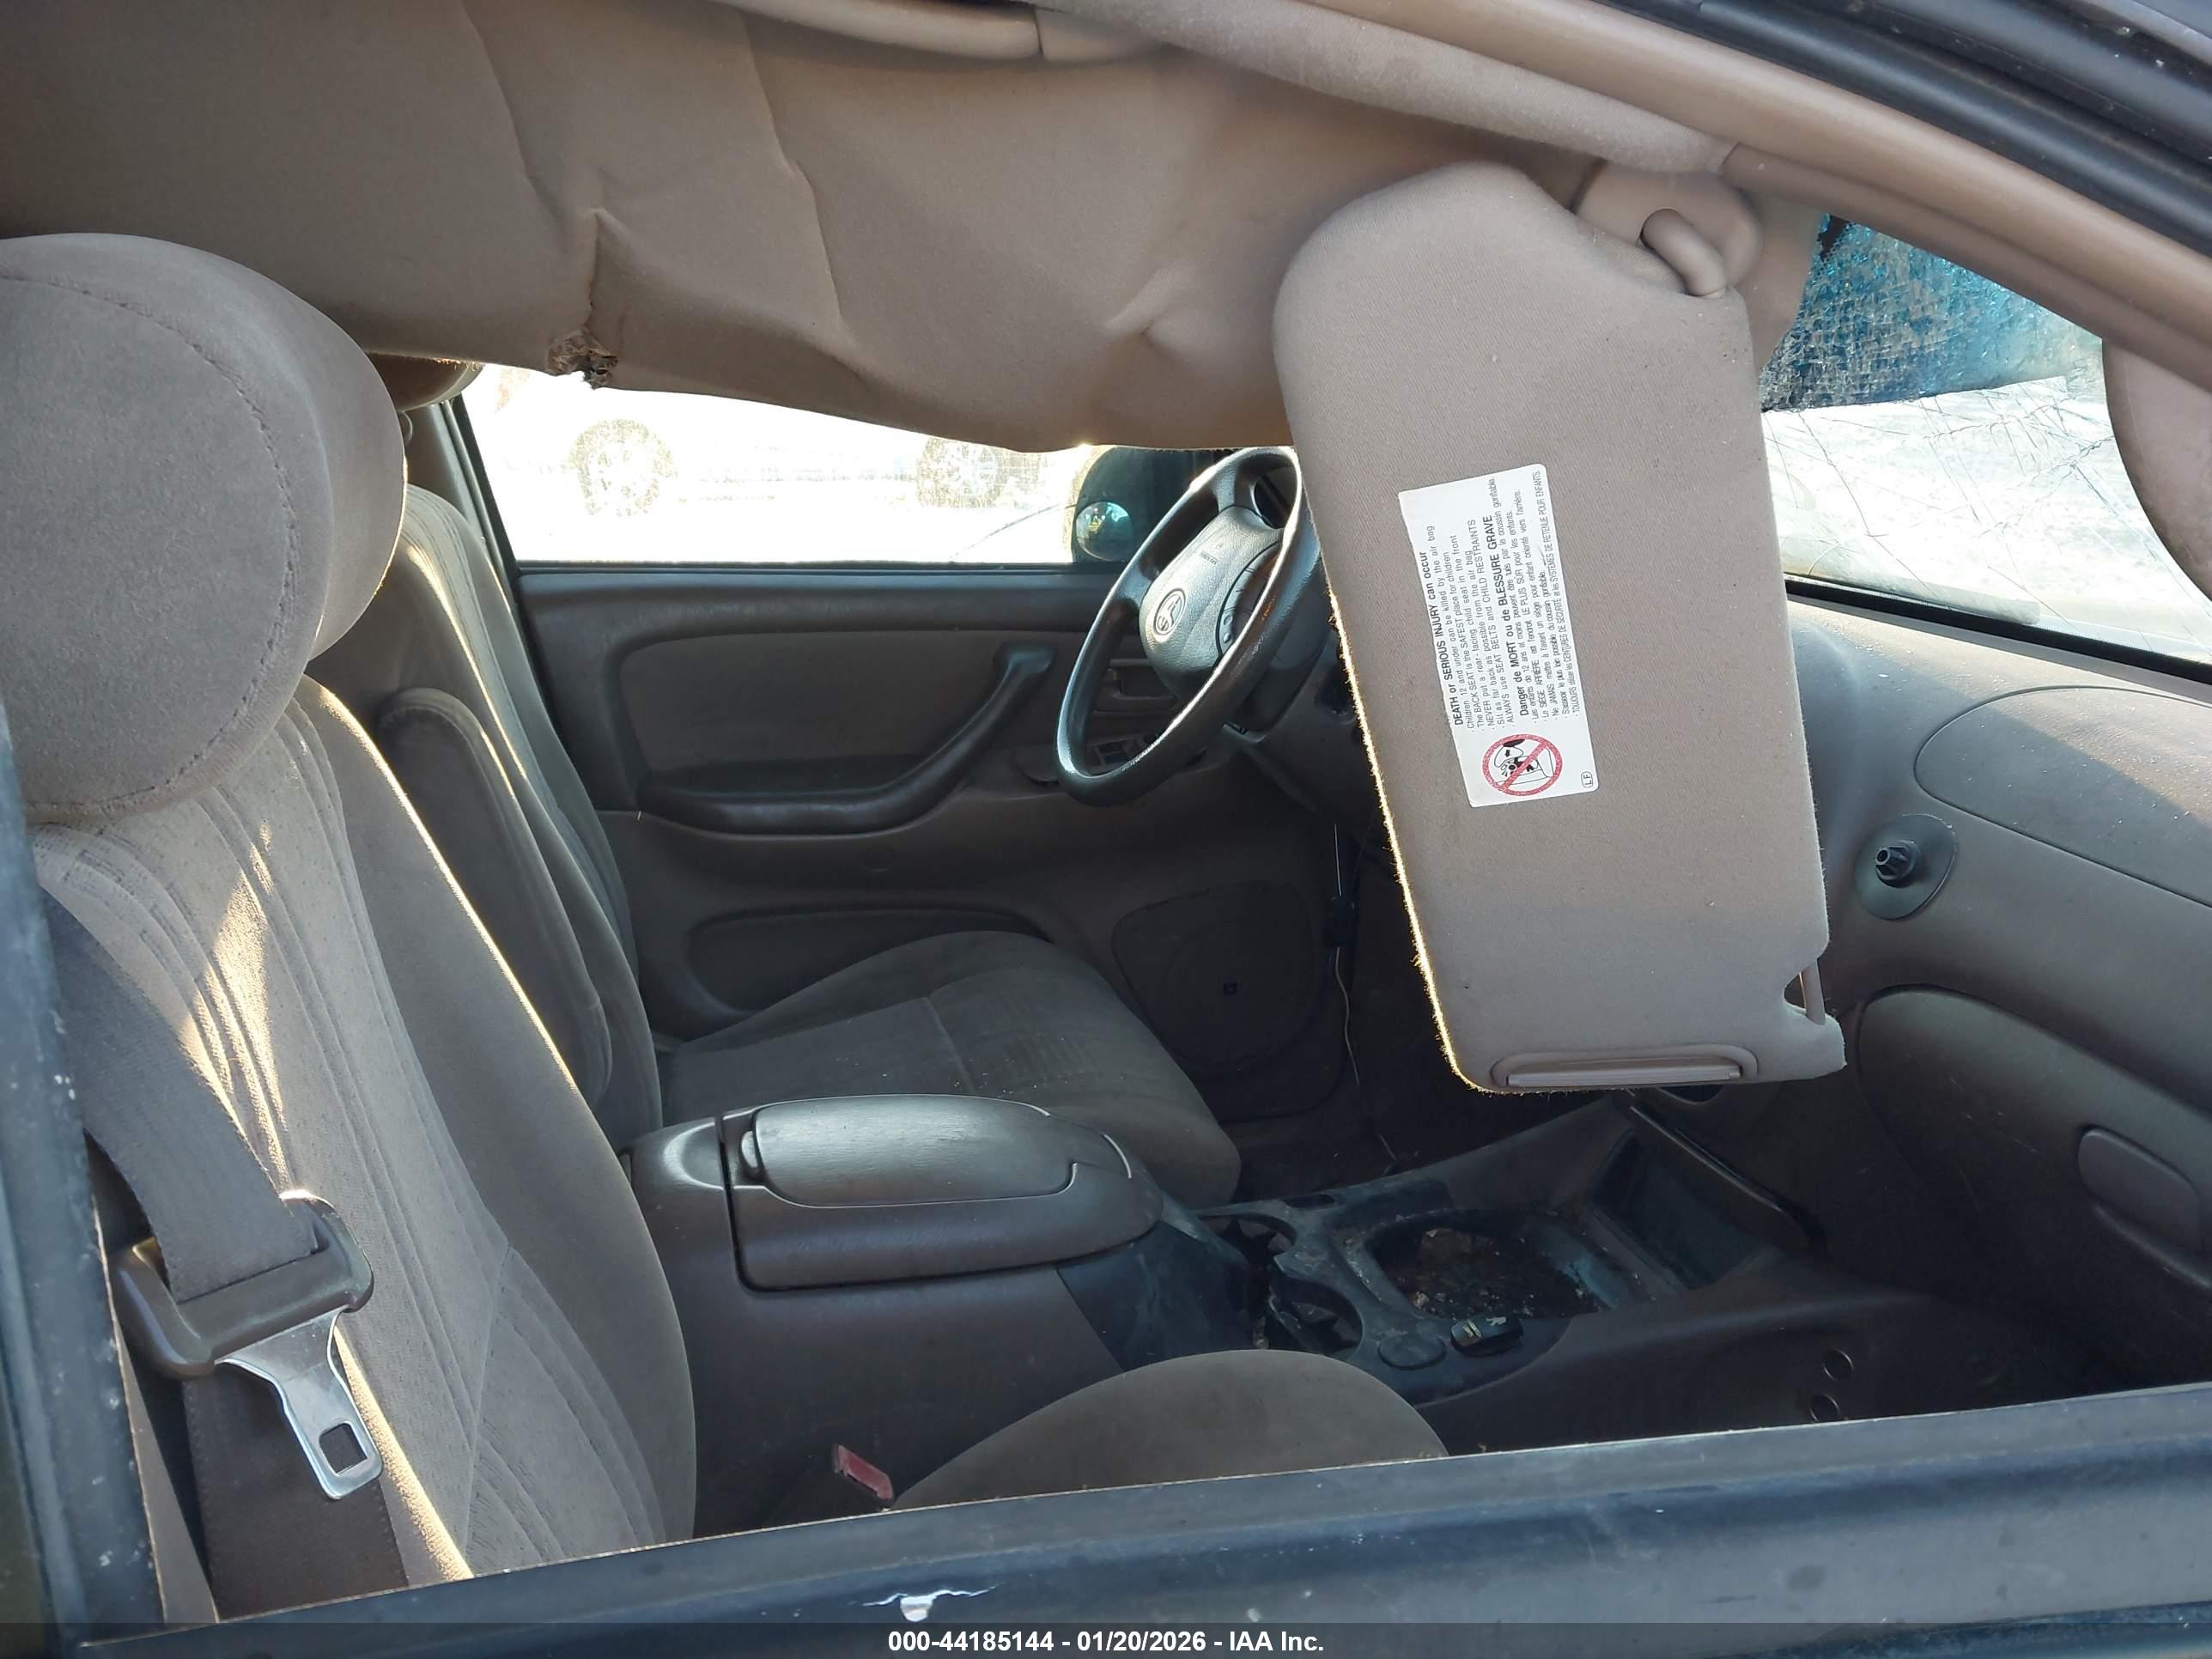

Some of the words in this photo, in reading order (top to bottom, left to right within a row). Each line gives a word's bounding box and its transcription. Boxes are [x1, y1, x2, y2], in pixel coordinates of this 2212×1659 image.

[1426, 526, 1435, 541] bag
[1483, 515, 1497, 550] GRAVE
[1449, 535, 1460, 555] front
[1468, 520, 1485, 574] RESTRAINTS
[1419, 552, 1431, 579] occur
[1443, 552, 1455, 582] children
[1437, 578, 1445, 586] by
[1490, 554, 1508, 605] BLESSURE
[1426, 583, 1436, 599] can
[1460, 586, 1469, 604] seat
[1479, 578, 1490, 603] CHILD
[1438, 591, 1449, 611] killed
[1452, 596, 1463, 616] place
[1474, 600, 1483, 617] from
[1430, 605, 1443, 637] INJURY
[1446, 615, 1452, 625] be
[1463, 608, 1474, 625] child
[1485, 606, 1494, 620] and
[1501, 610, 1510, 621] de
[1455, 618, 1468, 648] SAFEST
[1479, 622, 1492, 652] possible
[1488, 625, 1499, 649] BELTS
[1505, 625, 1513, 637] ou
[1437, 641, 1453, 680] SERIOUS
[1451, 646, 1462, 666] under
[1486, 656, 1492, 665] as
[1494, 654, 1504, 673] SEAT
[1506, 641, 1519, 667] MORT
[1455, 670, 1465, 684] and
[1466, 672, 1477, 690] SEAT
[1487, 668, 1497, 685] back
[1513, 672, 1522, 682] de
[1449, 684, 1456, 693] or
[1480, 685, 1491, 696] put
[1452, 696, 1463, 725] DEATH
[1470, 692, 1481, 713] BACK
[1495, 702, 1502, 710] as
[1502, 694, 1514, 722] ALWAYS
[1517, 686, 1528, 716] Danger
[1463, 701, 1474, 728] Children
[1483, 701, 1495, 726] NEVER
[1496, 714, 1504, 725] Sit
